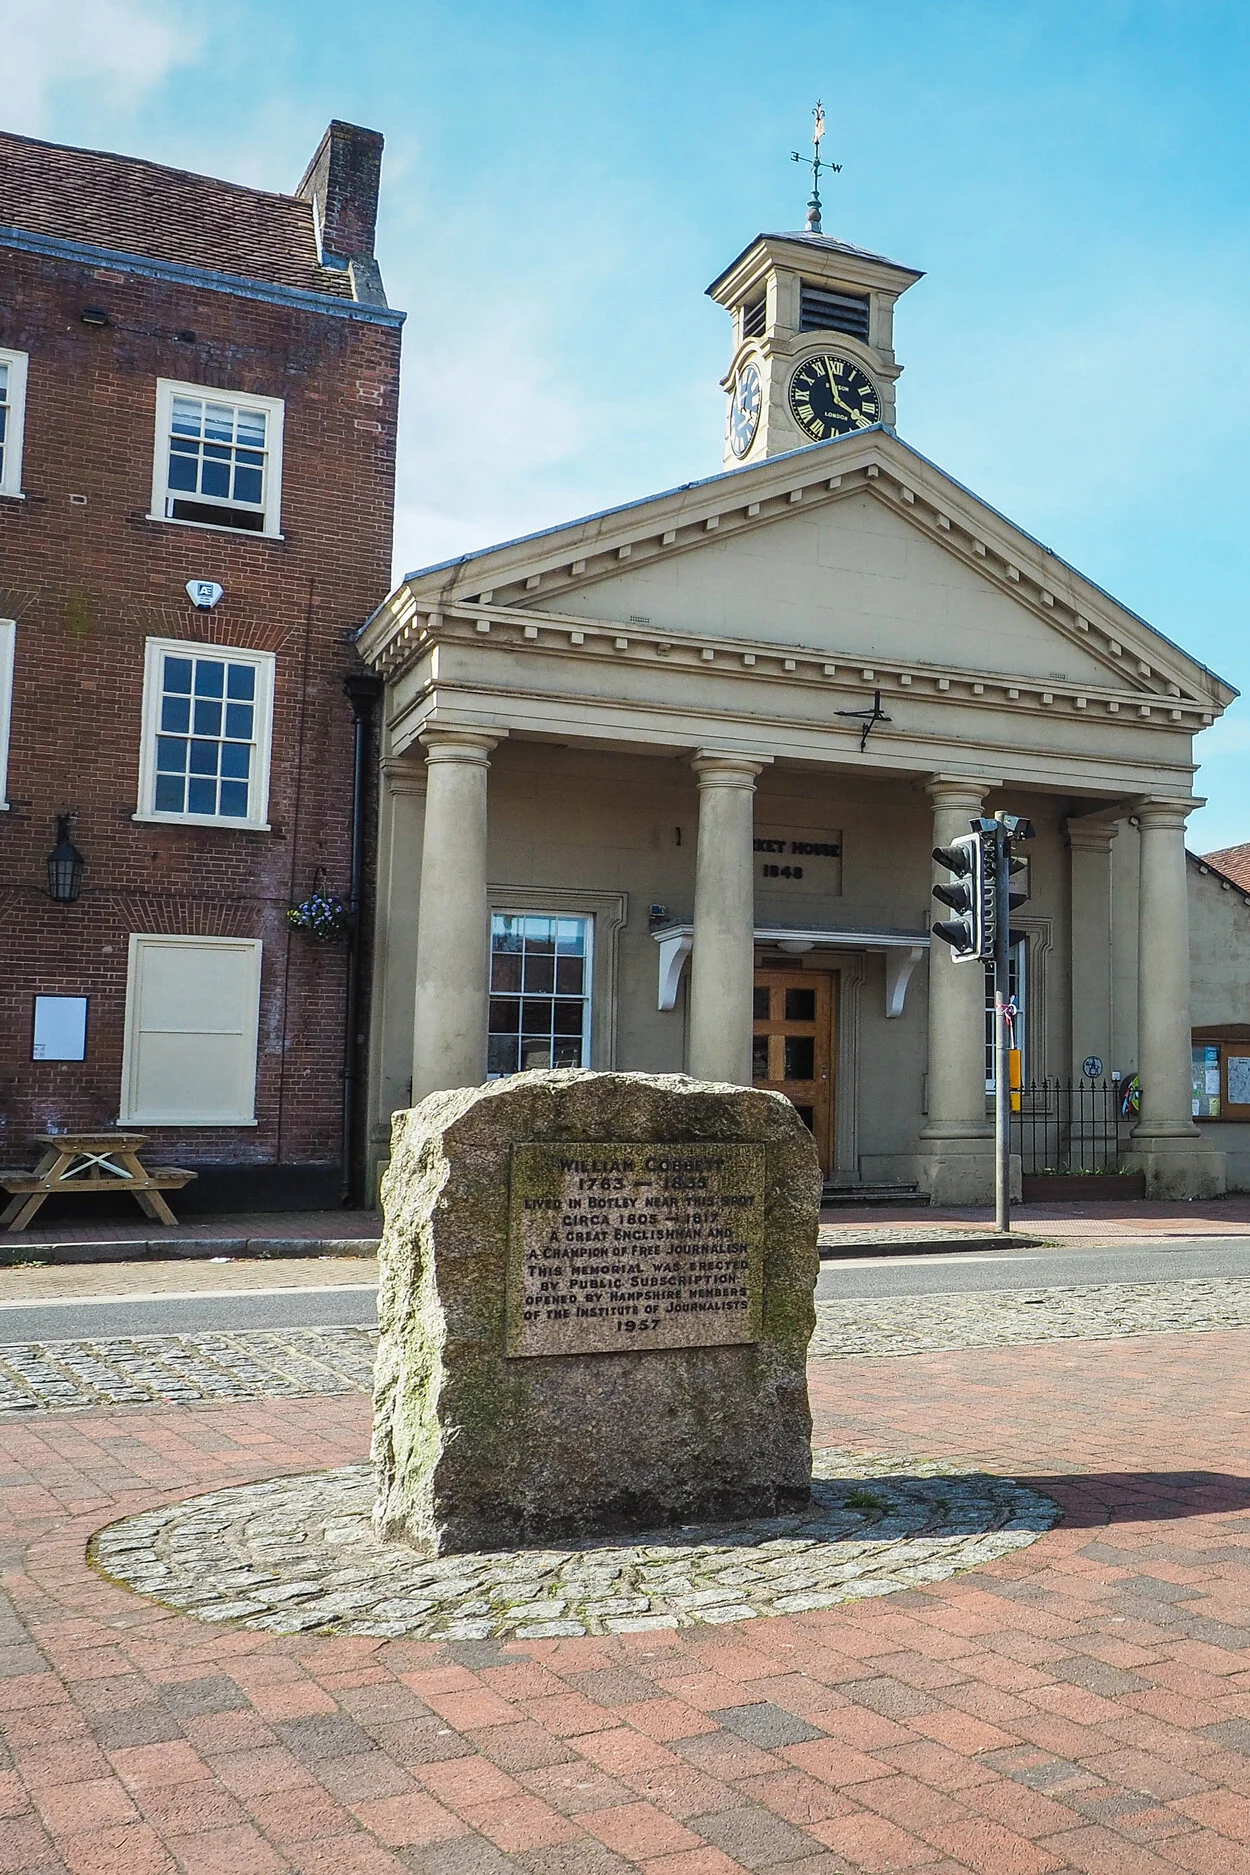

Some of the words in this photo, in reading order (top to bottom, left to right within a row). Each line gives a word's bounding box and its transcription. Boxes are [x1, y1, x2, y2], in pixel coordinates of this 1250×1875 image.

[825, 382, 850, 392] BSON
[824, 411, 848, 422] LONDON
[791, 841, 841, 858] HOUSE
[763, 863, 804, 880] 1848
[559, 1157, 634, 1173] WILLIAM
[578, 1178, 625, 1191] 1763
[523, 1198, 562, 1210] LIVED
[568, 1197, 582, 1209] IN
[588, 1196, 638, 1209] BOTLEY
[645, 1197, 677, 1208] NEAR
[686, 1196, 714, 1207] THIS
[562, 1213, 610, 1227] CIRCA
[618, 1212, 659, 1225] 1805
[685, 1212, 719, 1224] 1817
[550, 1231, 560, 1243] A
[565, 1231, 609, 1243] GREAT
[614, 1228, 701, 1241] ENGLISHMAN
[707, 1228, 733, 1239] AND
[528, 1250, 539, 1260] A
[542, 1247, 609, 1260] CHAMPION
[612, 1246, 627, 1257] OF
[631, 1244, 661, 1257] FREE
[665, 1242, 748, 1256] JOURNALISM
[527, 1265, 564, 1278] THIS
[571, 1263, 644, 1276] MEMORIAL
[652, 1262, 681, 1274] WAS
[689, 1259, 748, 1272] ERECTED
[540, 1281, 560, 1292] BY
[569, 1278, 622, 1290] PUBLIC
[630, 1273, 737, 1288] SUBSCRIPTION
[525, 1294, 578, 1306] OPENED
[585, 1293, 604, 1304] BY
[609, 1289, 682, 1302] HAMPSHIRE
[689, 1287, 748, 1299] MEMBERS
[523, 1310, 541, 1321] OF
[546, 1308, 570, 1320] THE
[576, 1305, 639, 1318] INSTITUTE
[644, 1303, 661, 1315] OF
[665, 1300, 748, 1314] JOURNALISTS
[616, 1318, 662, 1332] 1957
